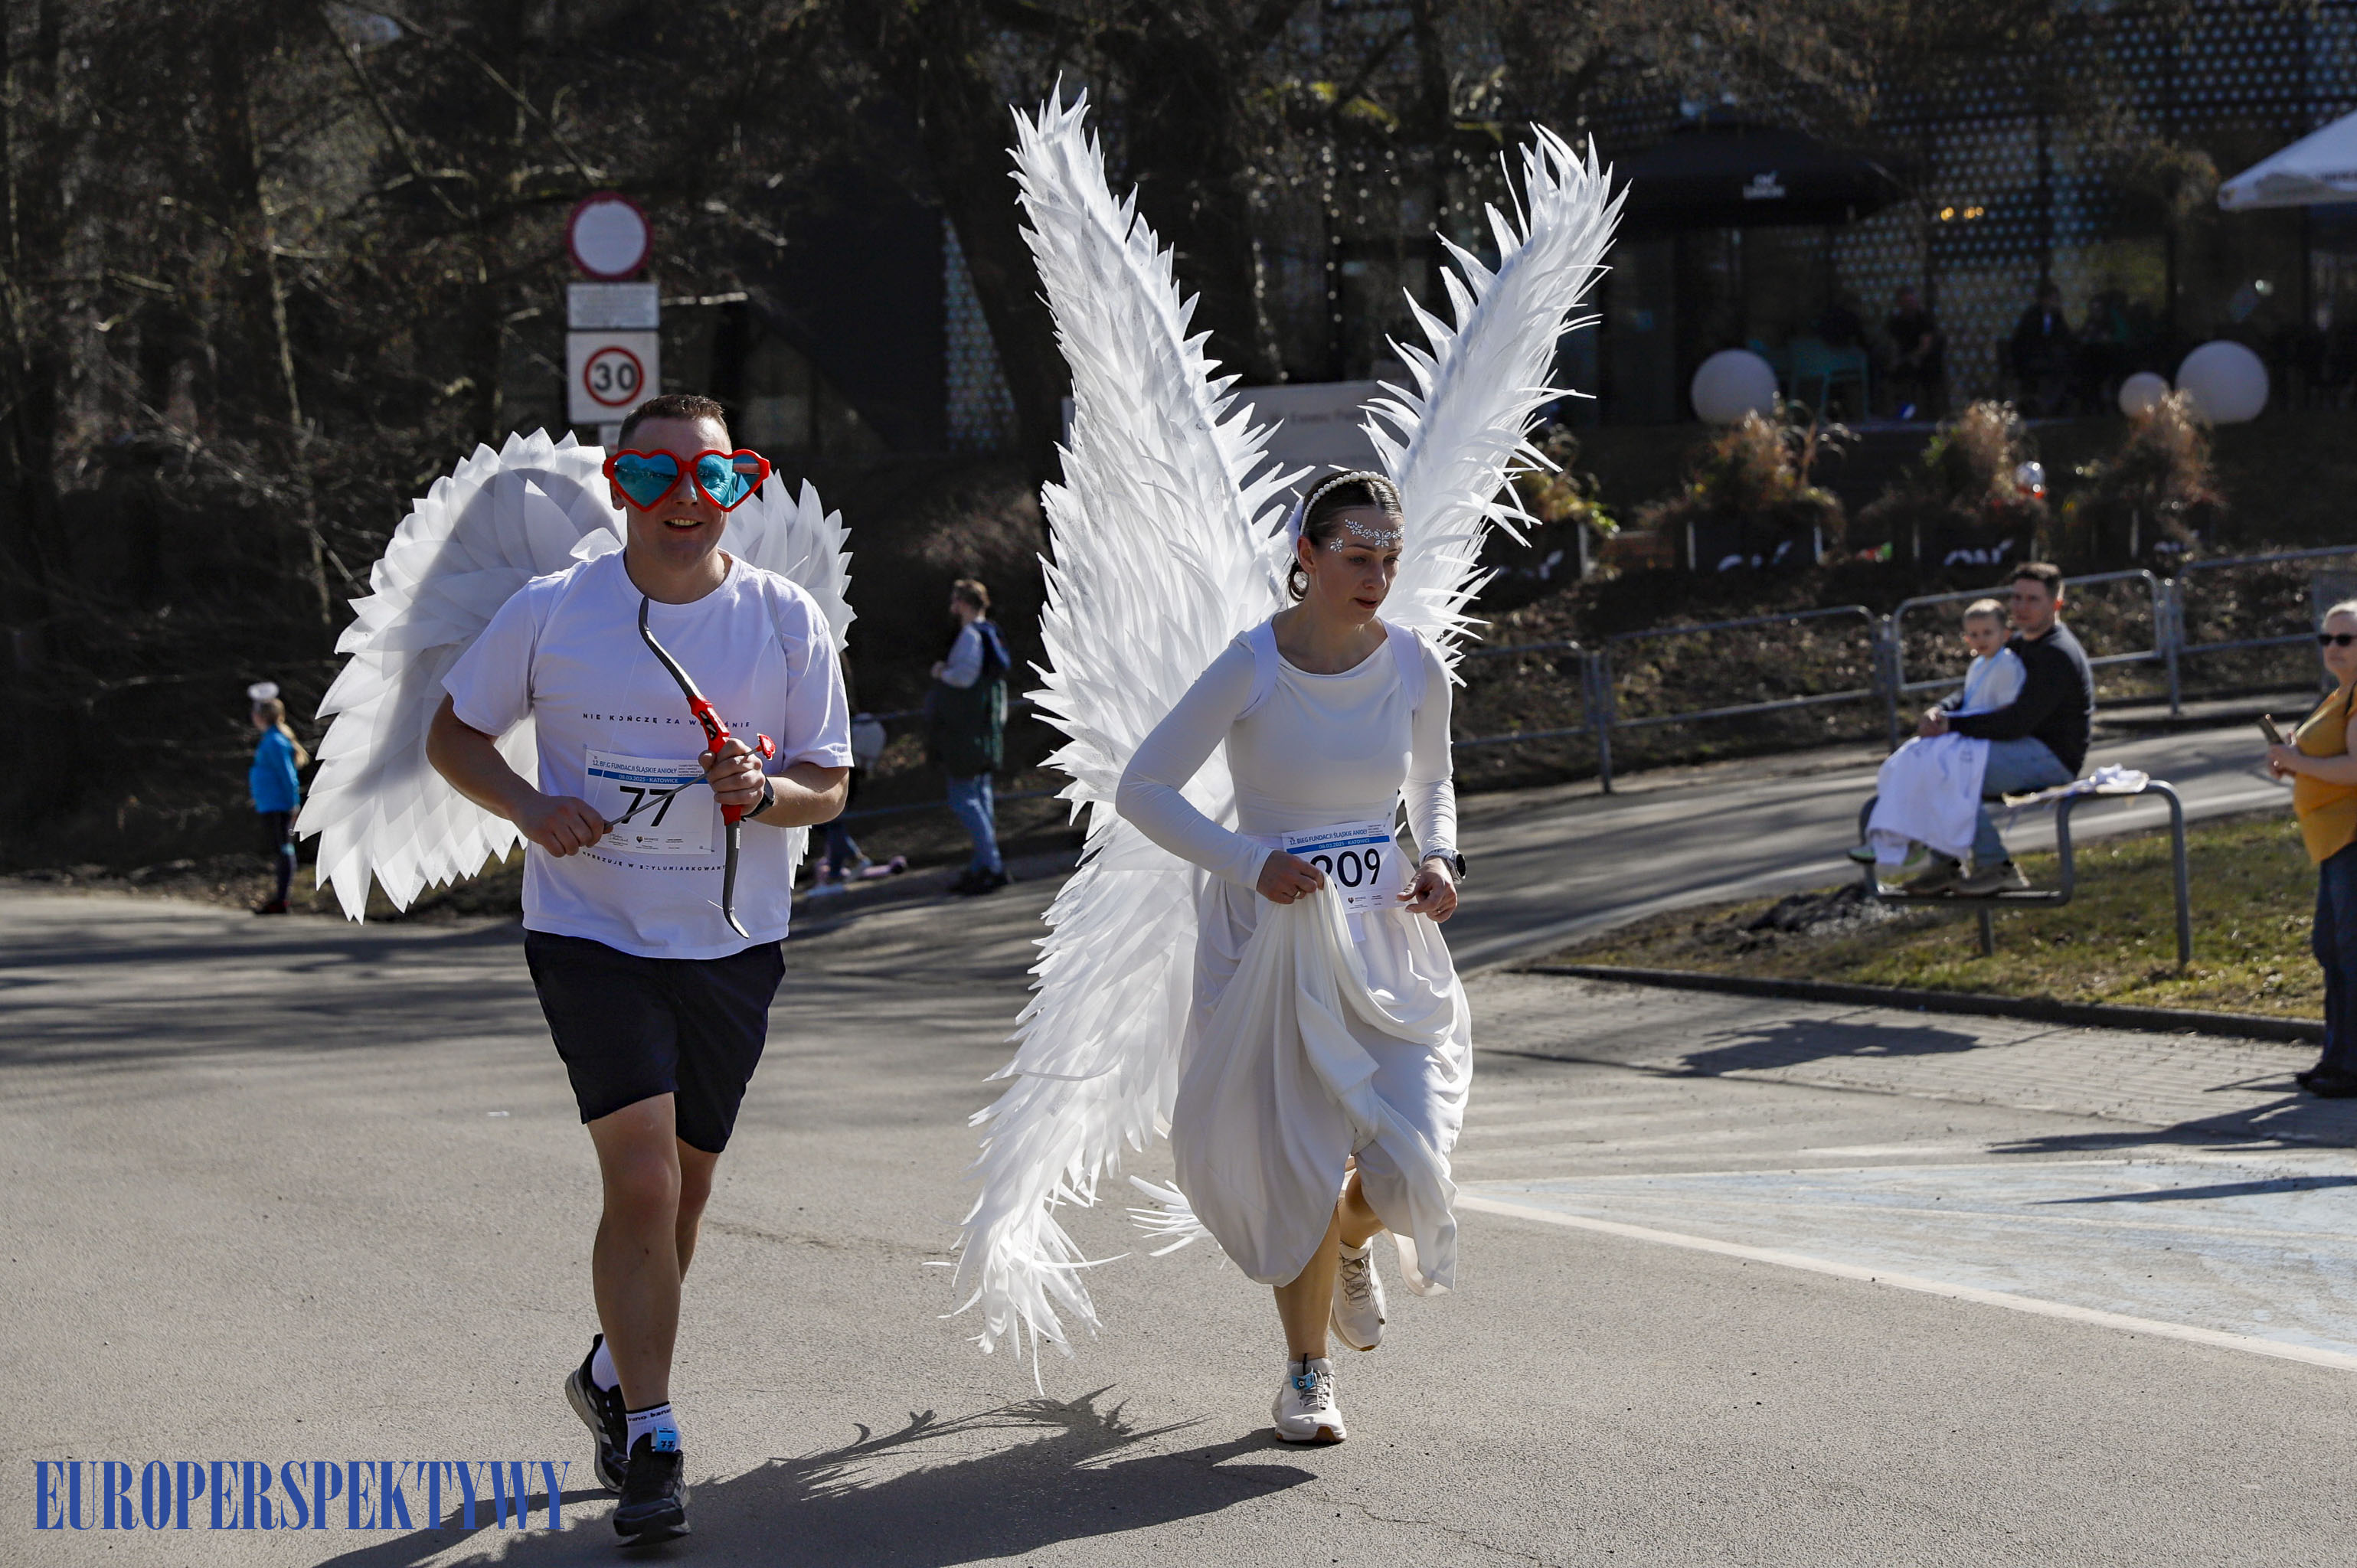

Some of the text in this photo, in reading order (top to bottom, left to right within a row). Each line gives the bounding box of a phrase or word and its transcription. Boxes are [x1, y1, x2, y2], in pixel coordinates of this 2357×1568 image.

[593, 362, 636, 391] 30
[610, 714, 658, 724] KOŃCZĘ
[611, 763, 636, 772] FUNDACJI
[636, 765, 657, 774] ŚLĄSKIE
[619, 786, 676, 827] 77
[1309, 834, 1333, 843] FUNDACJI
[1333, 831, 1352, 839] ŚLĄSKIE
